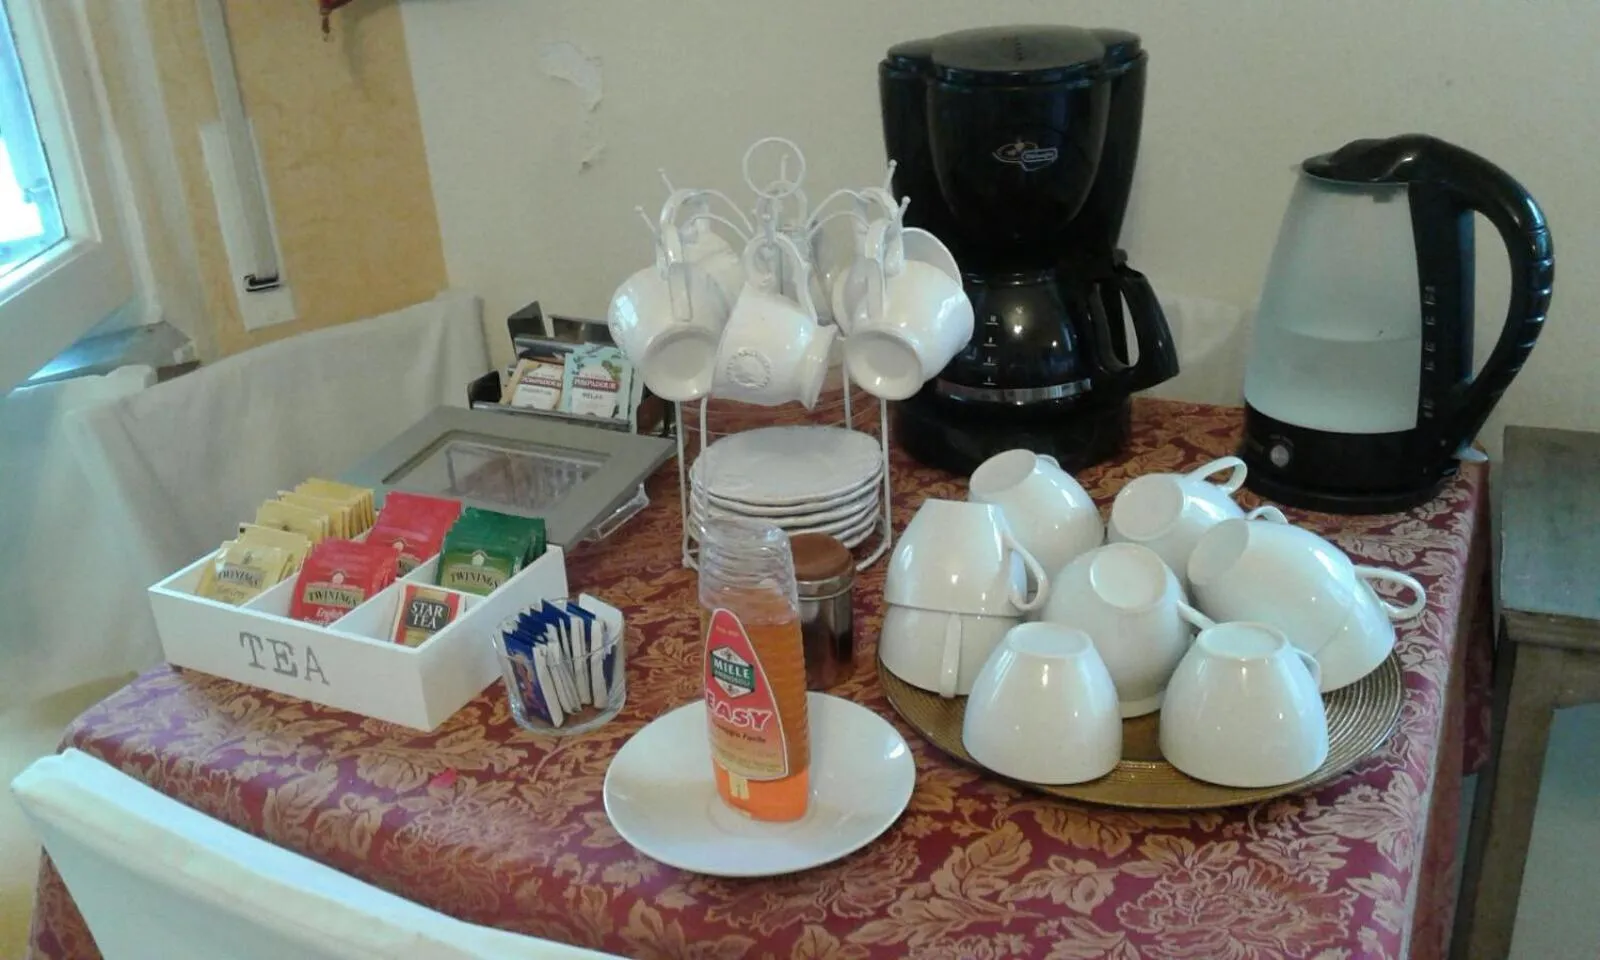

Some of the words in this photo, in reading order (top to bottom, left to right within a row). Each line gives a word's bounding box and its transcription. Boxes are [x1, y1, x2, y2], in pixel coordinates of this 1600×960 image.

[450, 570, 498, 590] TWININGS
[411, 601, 443, 618] STAR
[413, 613, 437, 629] TEA
[239, 630, 331, 686] TEA
[713, 656, 751, 679] MIELE
[705, 689, 773, 732] EASY
